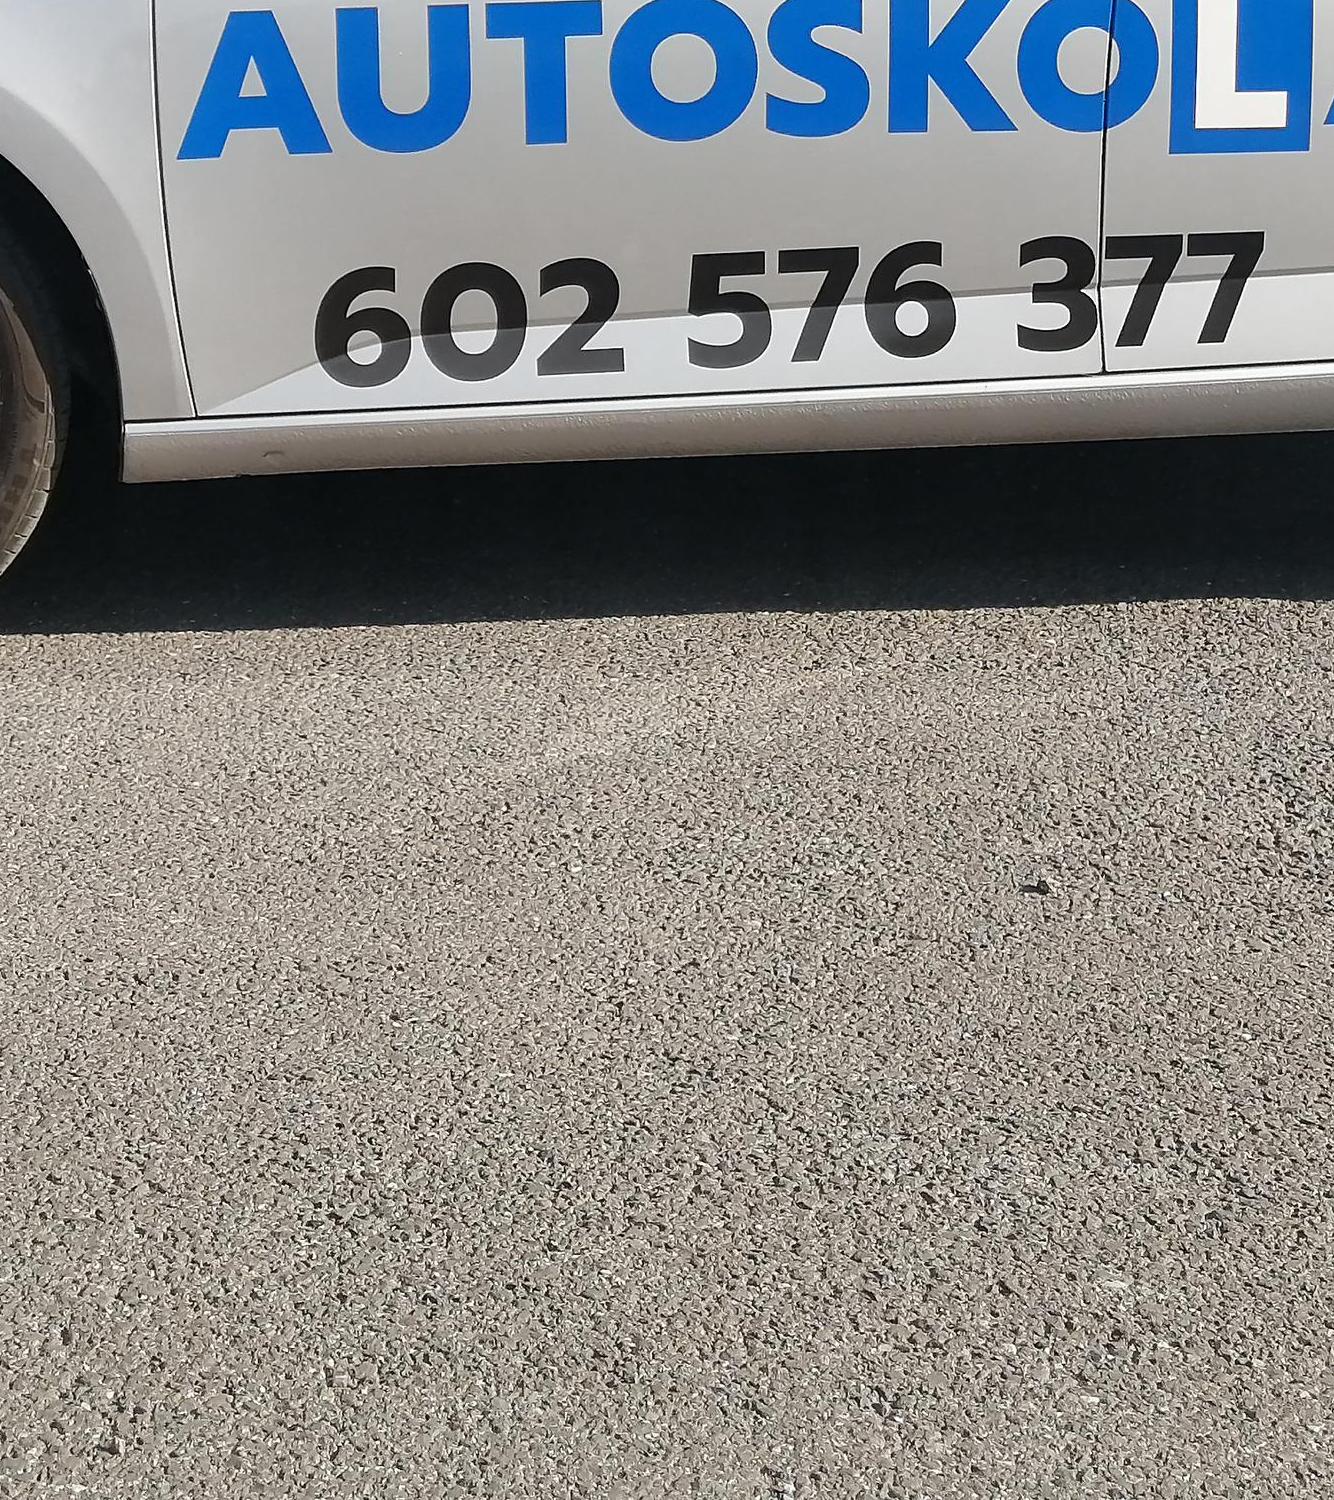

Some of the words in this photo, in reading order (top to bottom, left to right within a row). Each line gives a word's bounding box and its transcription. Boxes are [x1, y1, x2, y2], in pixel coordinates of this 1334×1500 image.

[314, 258, 625, 388] 602
[688, 240, 958, 369] 576
[1017, 231, 1266, 352] 377
